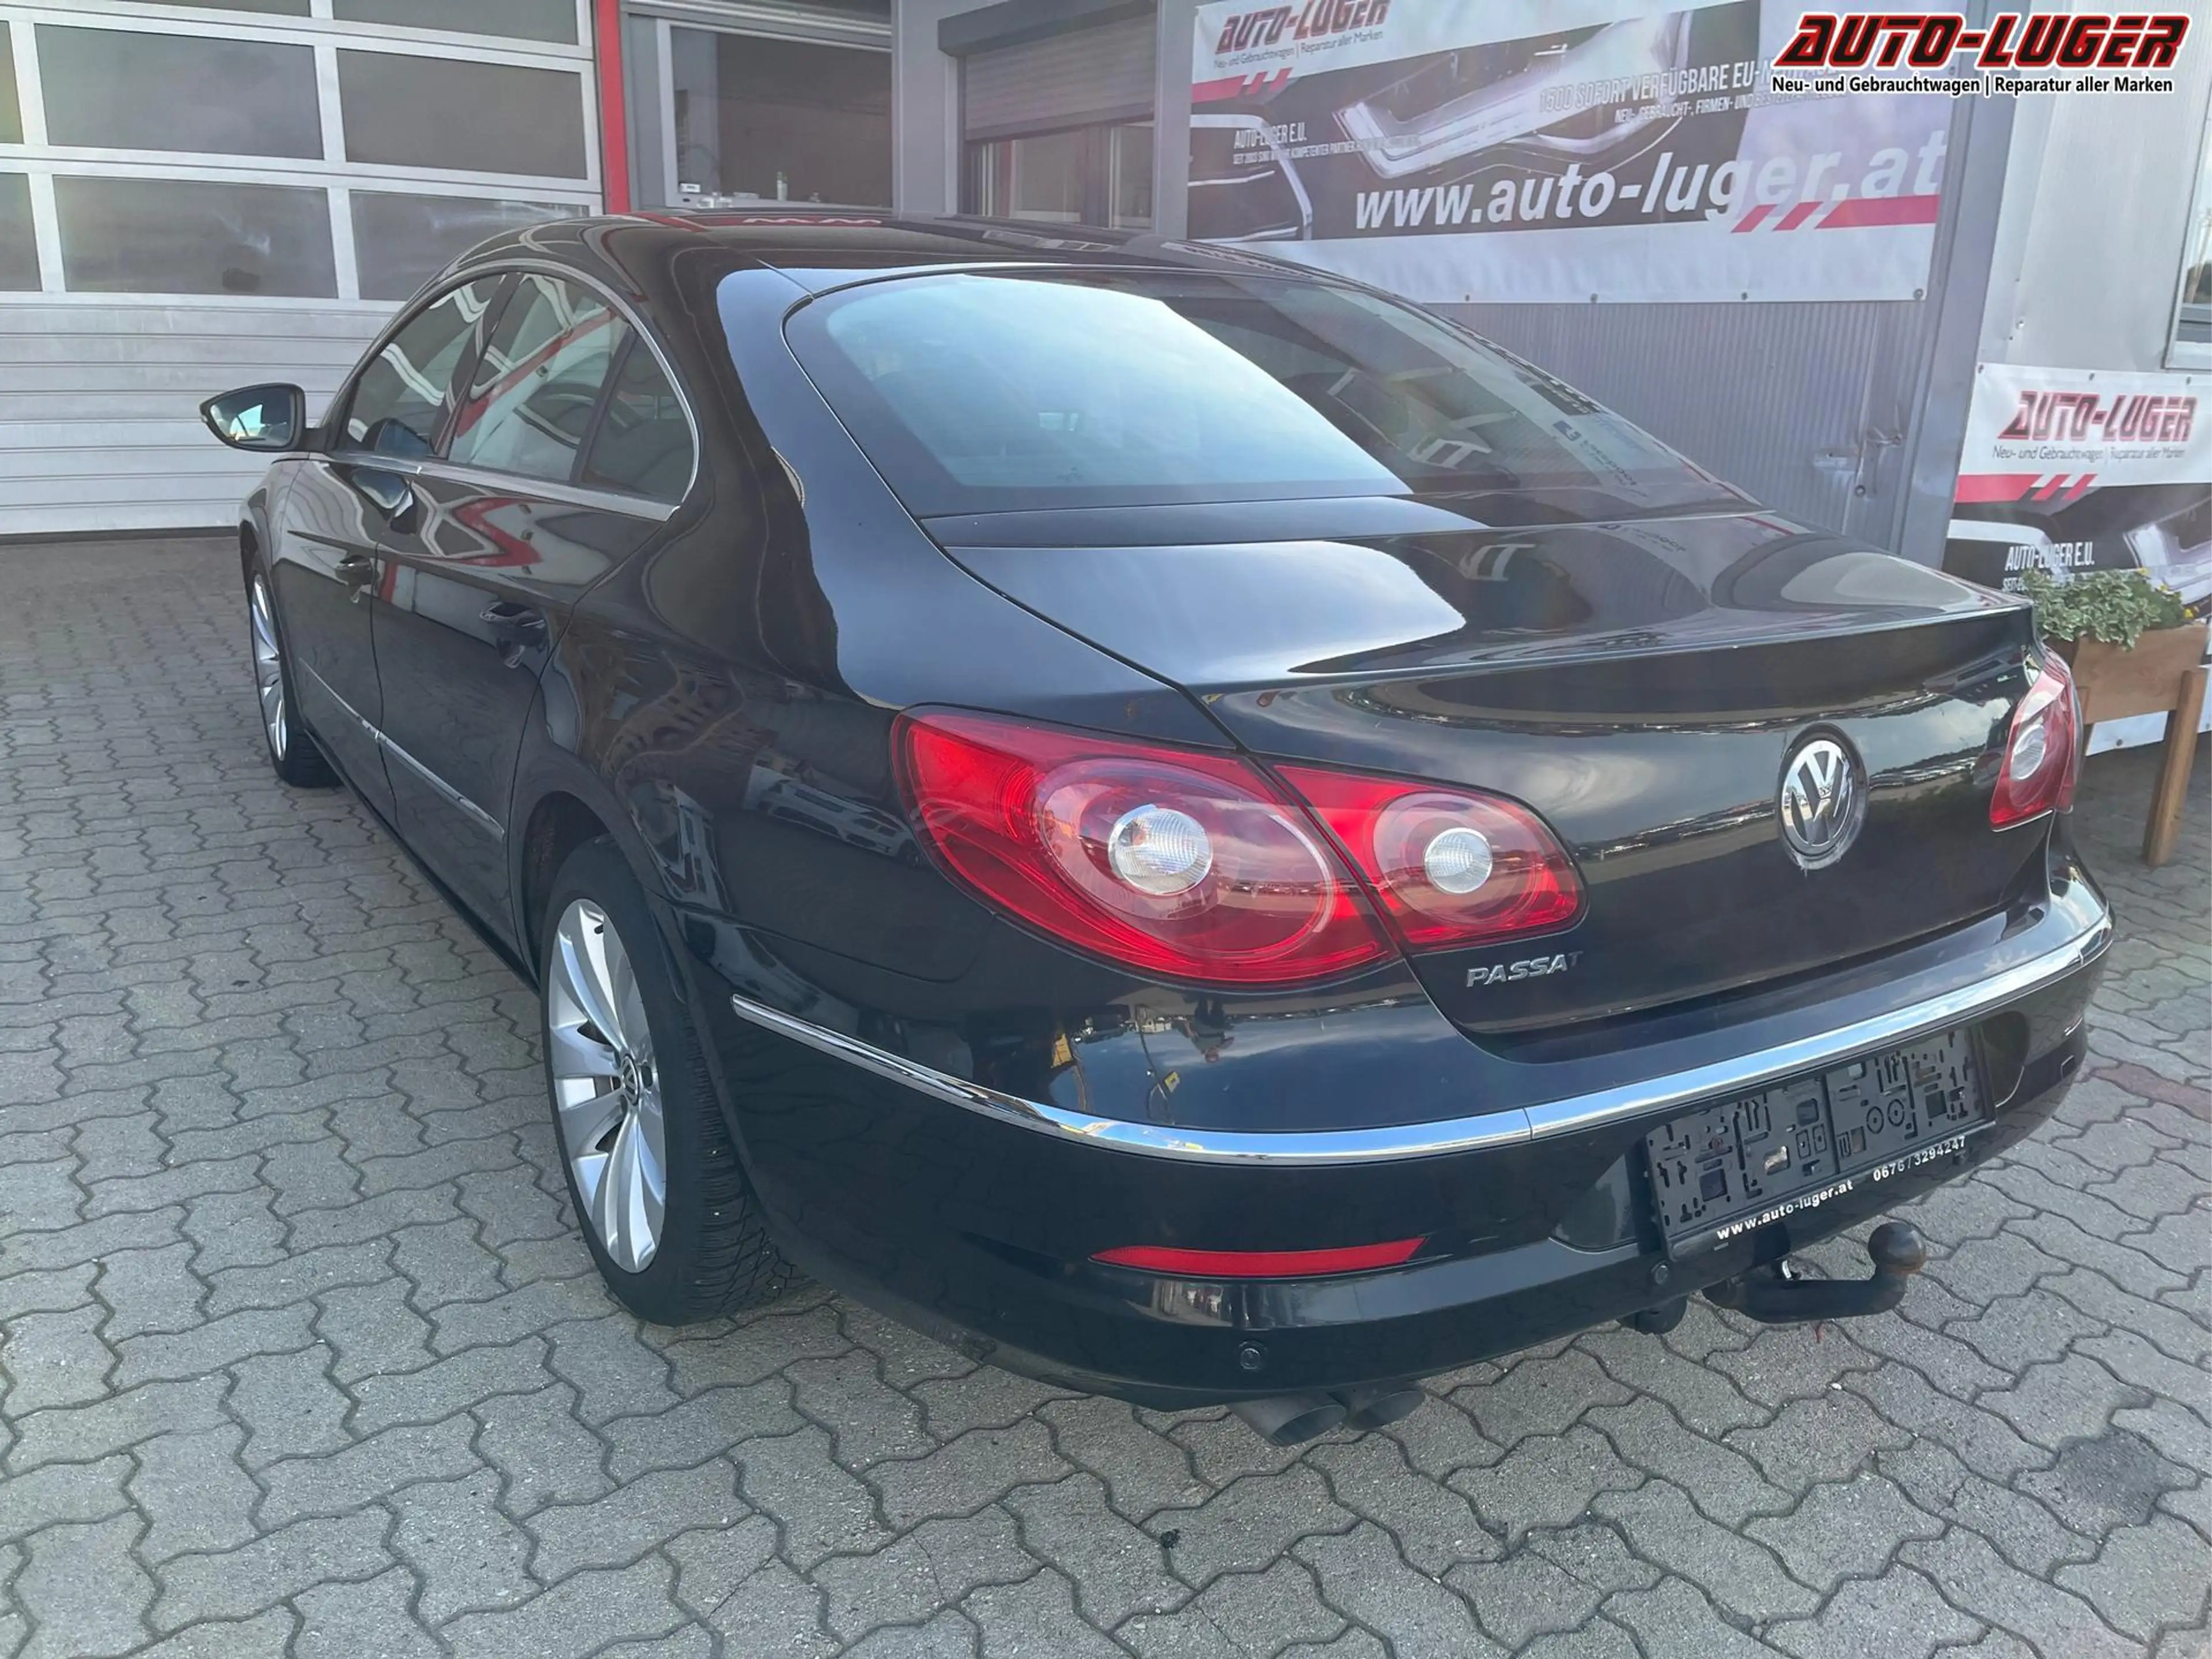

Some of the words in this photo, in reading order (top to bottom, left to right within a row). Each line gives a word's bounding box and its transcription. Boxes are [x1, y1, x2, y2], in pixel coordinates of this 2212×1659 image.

[1215, 0, 1391, 54] AUTO-LUGER
[1539, 86, 1574, 113] 1500
[1575, 76, 1631, 109] SOFORT
[1631, 64, 1730, 101] VERFÜGBARE
[1355, 130, 1946, 229] www.auto-luger.at
[1998, 390, 2198, 442] AUTO-LUGER
[1466, 950, 1583, 987] PASSAT
[1716, 1180, 1853, 1240] www.auto-luger.at
